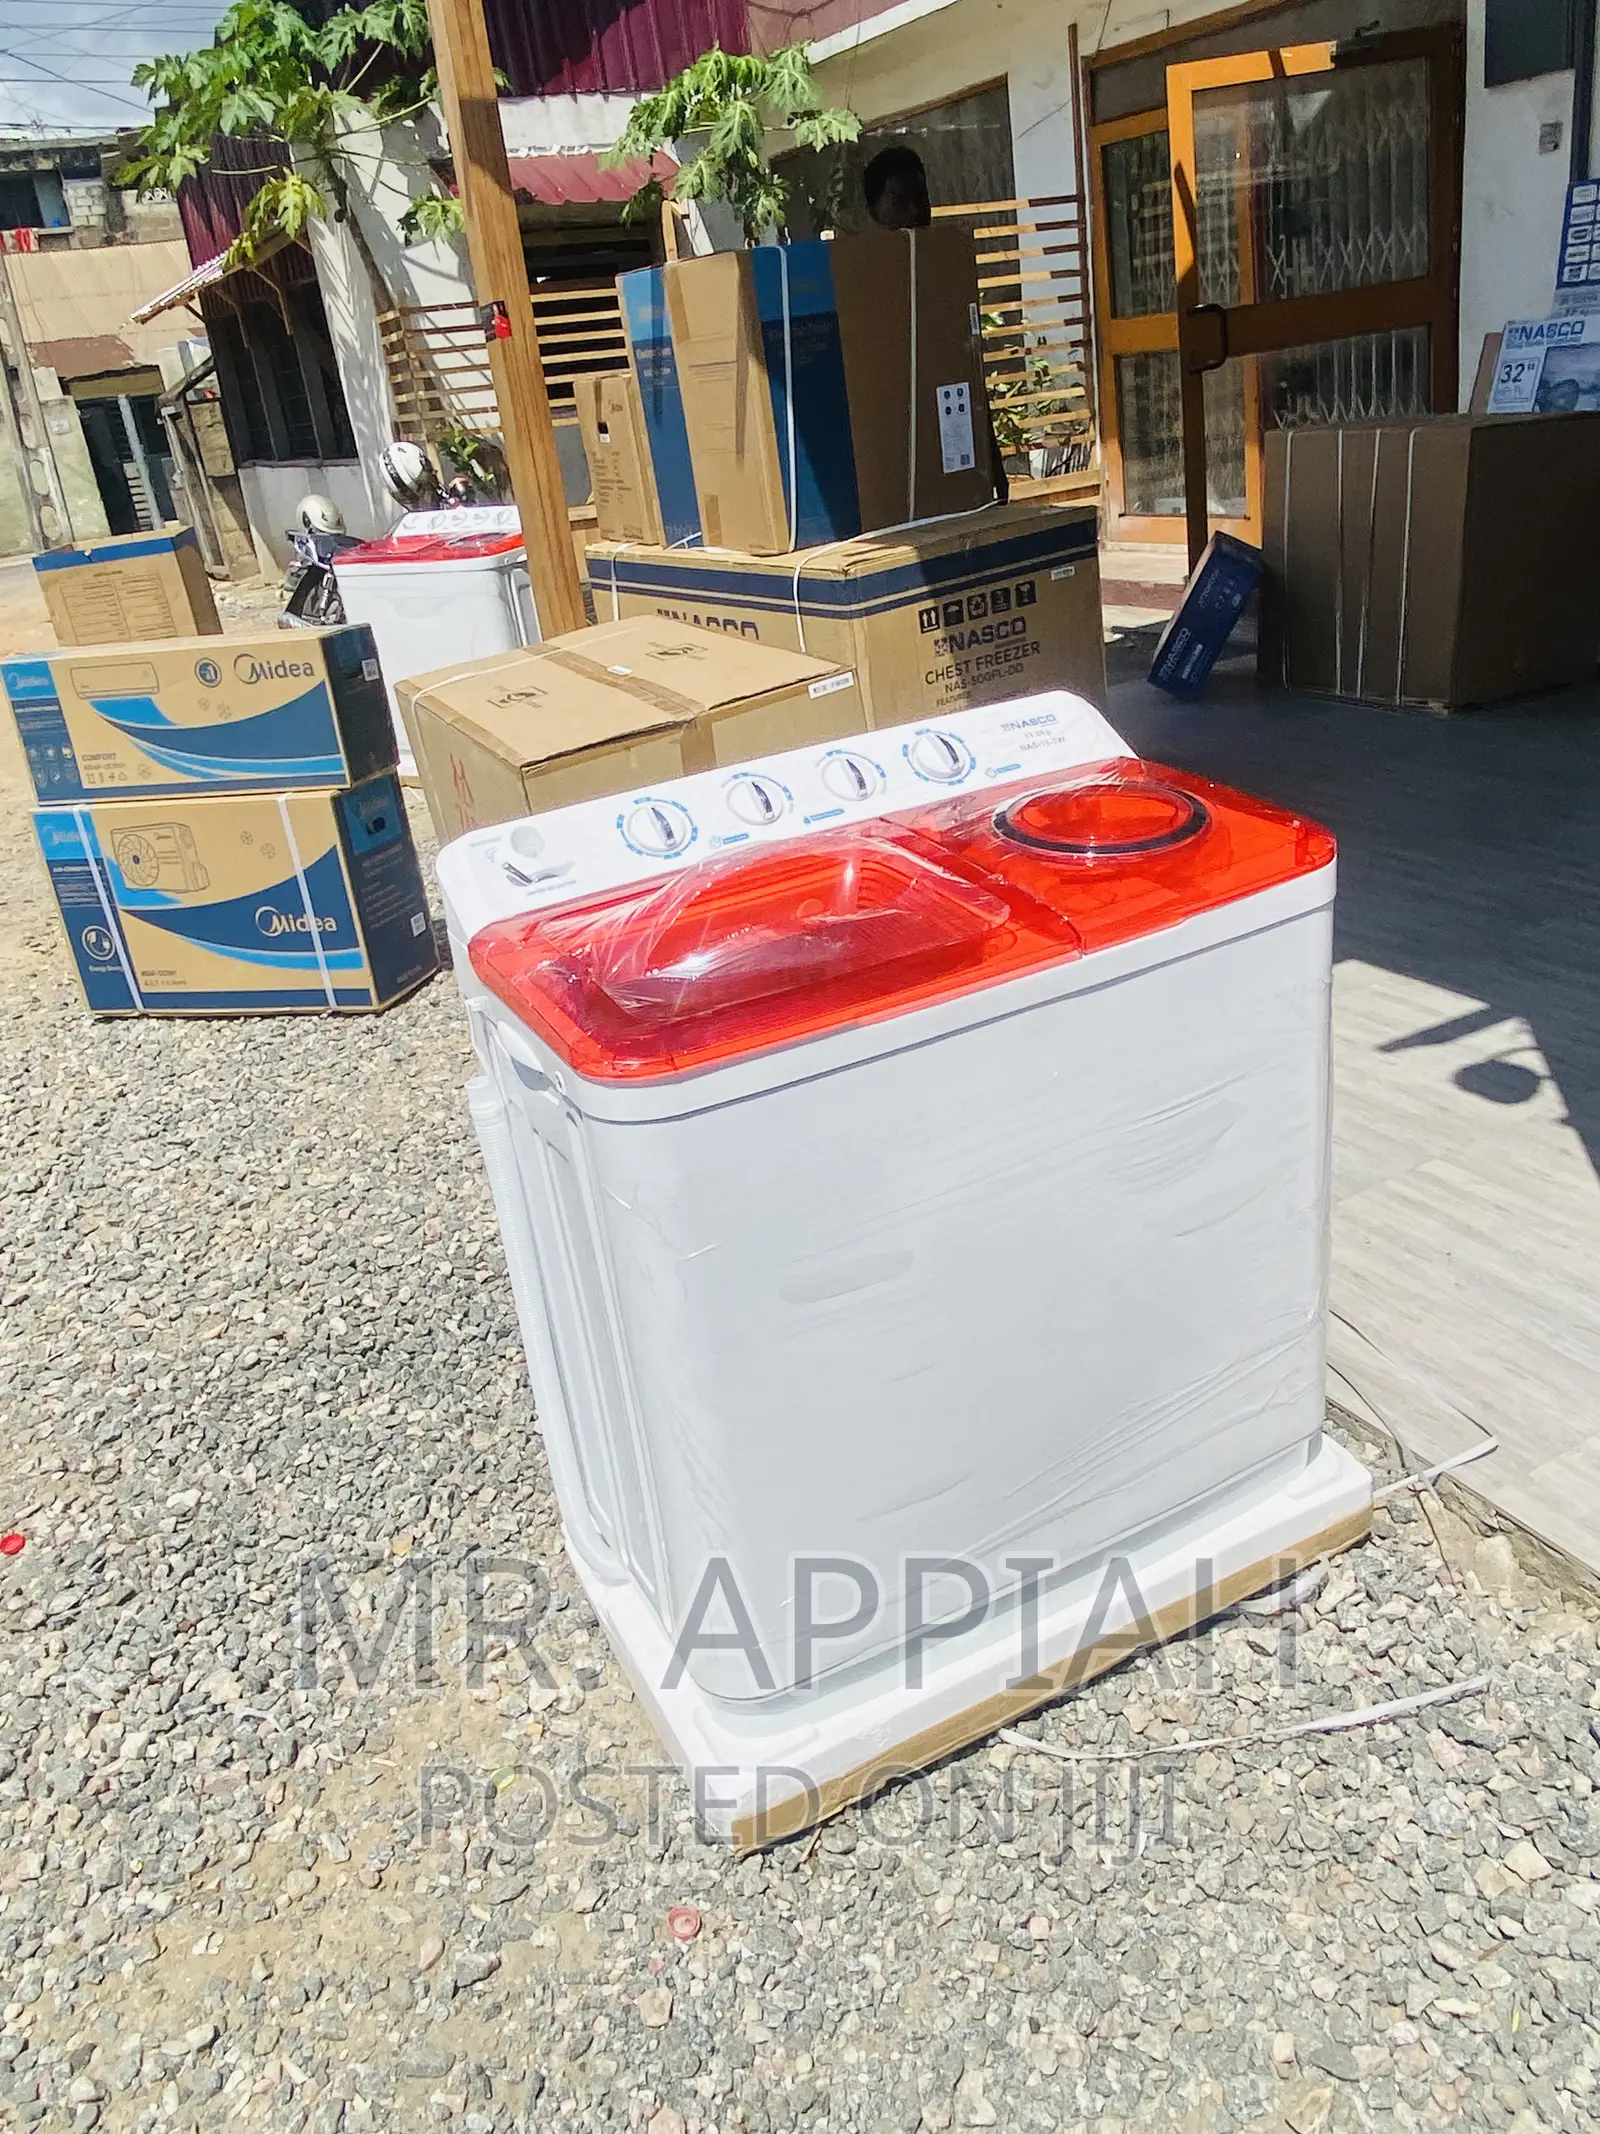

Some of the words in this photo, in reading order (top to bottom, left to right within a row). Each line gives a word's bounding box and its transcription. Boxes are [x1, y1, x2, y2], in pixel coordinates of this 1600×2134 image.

[1519, 320, 1586, 341] NASCO
[950, 616, 1026, 652] NASCO
[233, 653, 315, 685] Midea
[925, 660, 972, 685] CHEST
[975, 641, 1041, 671] FREEZER
[1011, 713, 1057, 731] NASCO
